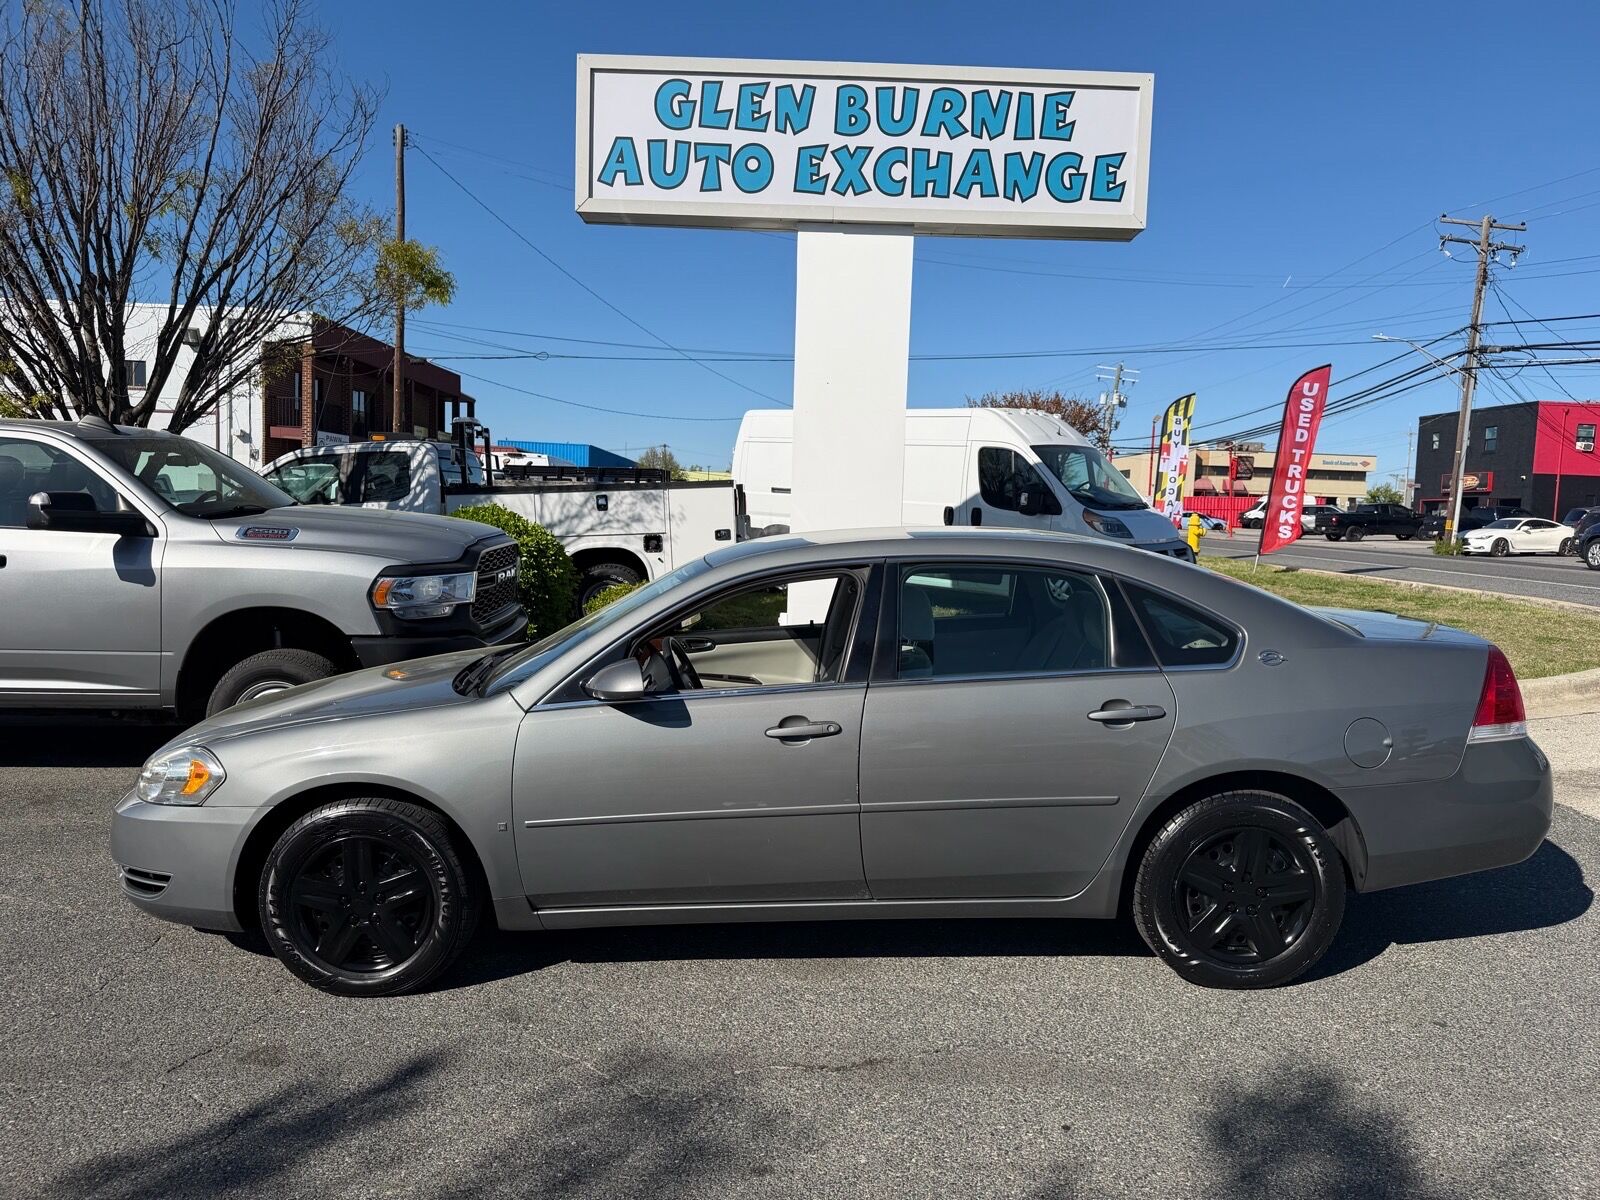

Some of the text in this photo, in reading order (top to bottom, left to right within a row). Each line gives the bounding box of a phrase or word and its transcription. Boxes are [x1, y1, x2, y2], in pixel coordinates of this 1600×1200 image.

[654, 79, 1076, 141] GLEN BURNIE
[598, 136, 1127, 202] AUTO EXCHANGE
[1278, 382, 1319, 539] USED TRUCKS
